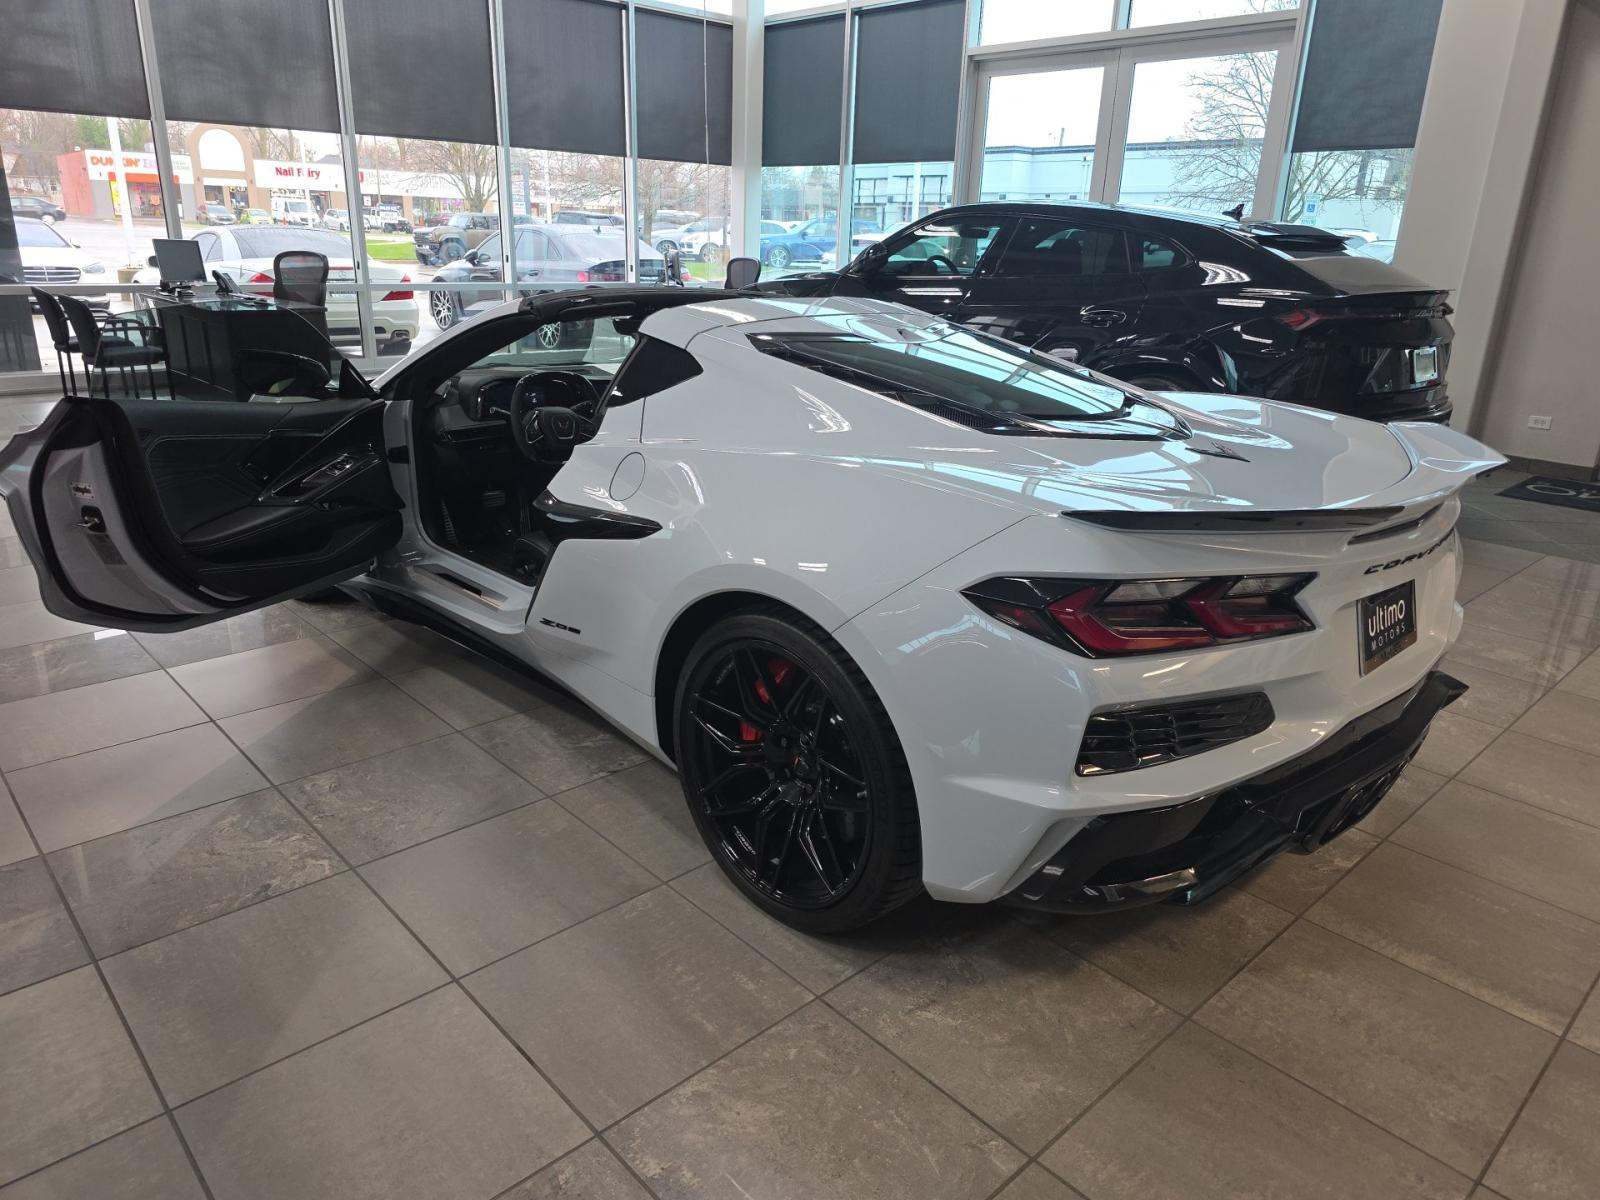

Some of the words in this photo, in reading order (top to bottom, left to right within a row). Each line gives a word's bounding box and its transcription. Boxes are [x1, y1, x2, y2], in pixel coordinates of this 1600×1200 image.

[90, 155, 140, 167] DUNIN'
[275, 166, 295, 177] Nail
[297, 167, 321, 180] Firy
[1368, 599, 1406, 637] ultimo
[1371, 622, 1406, 651] MOTORS
